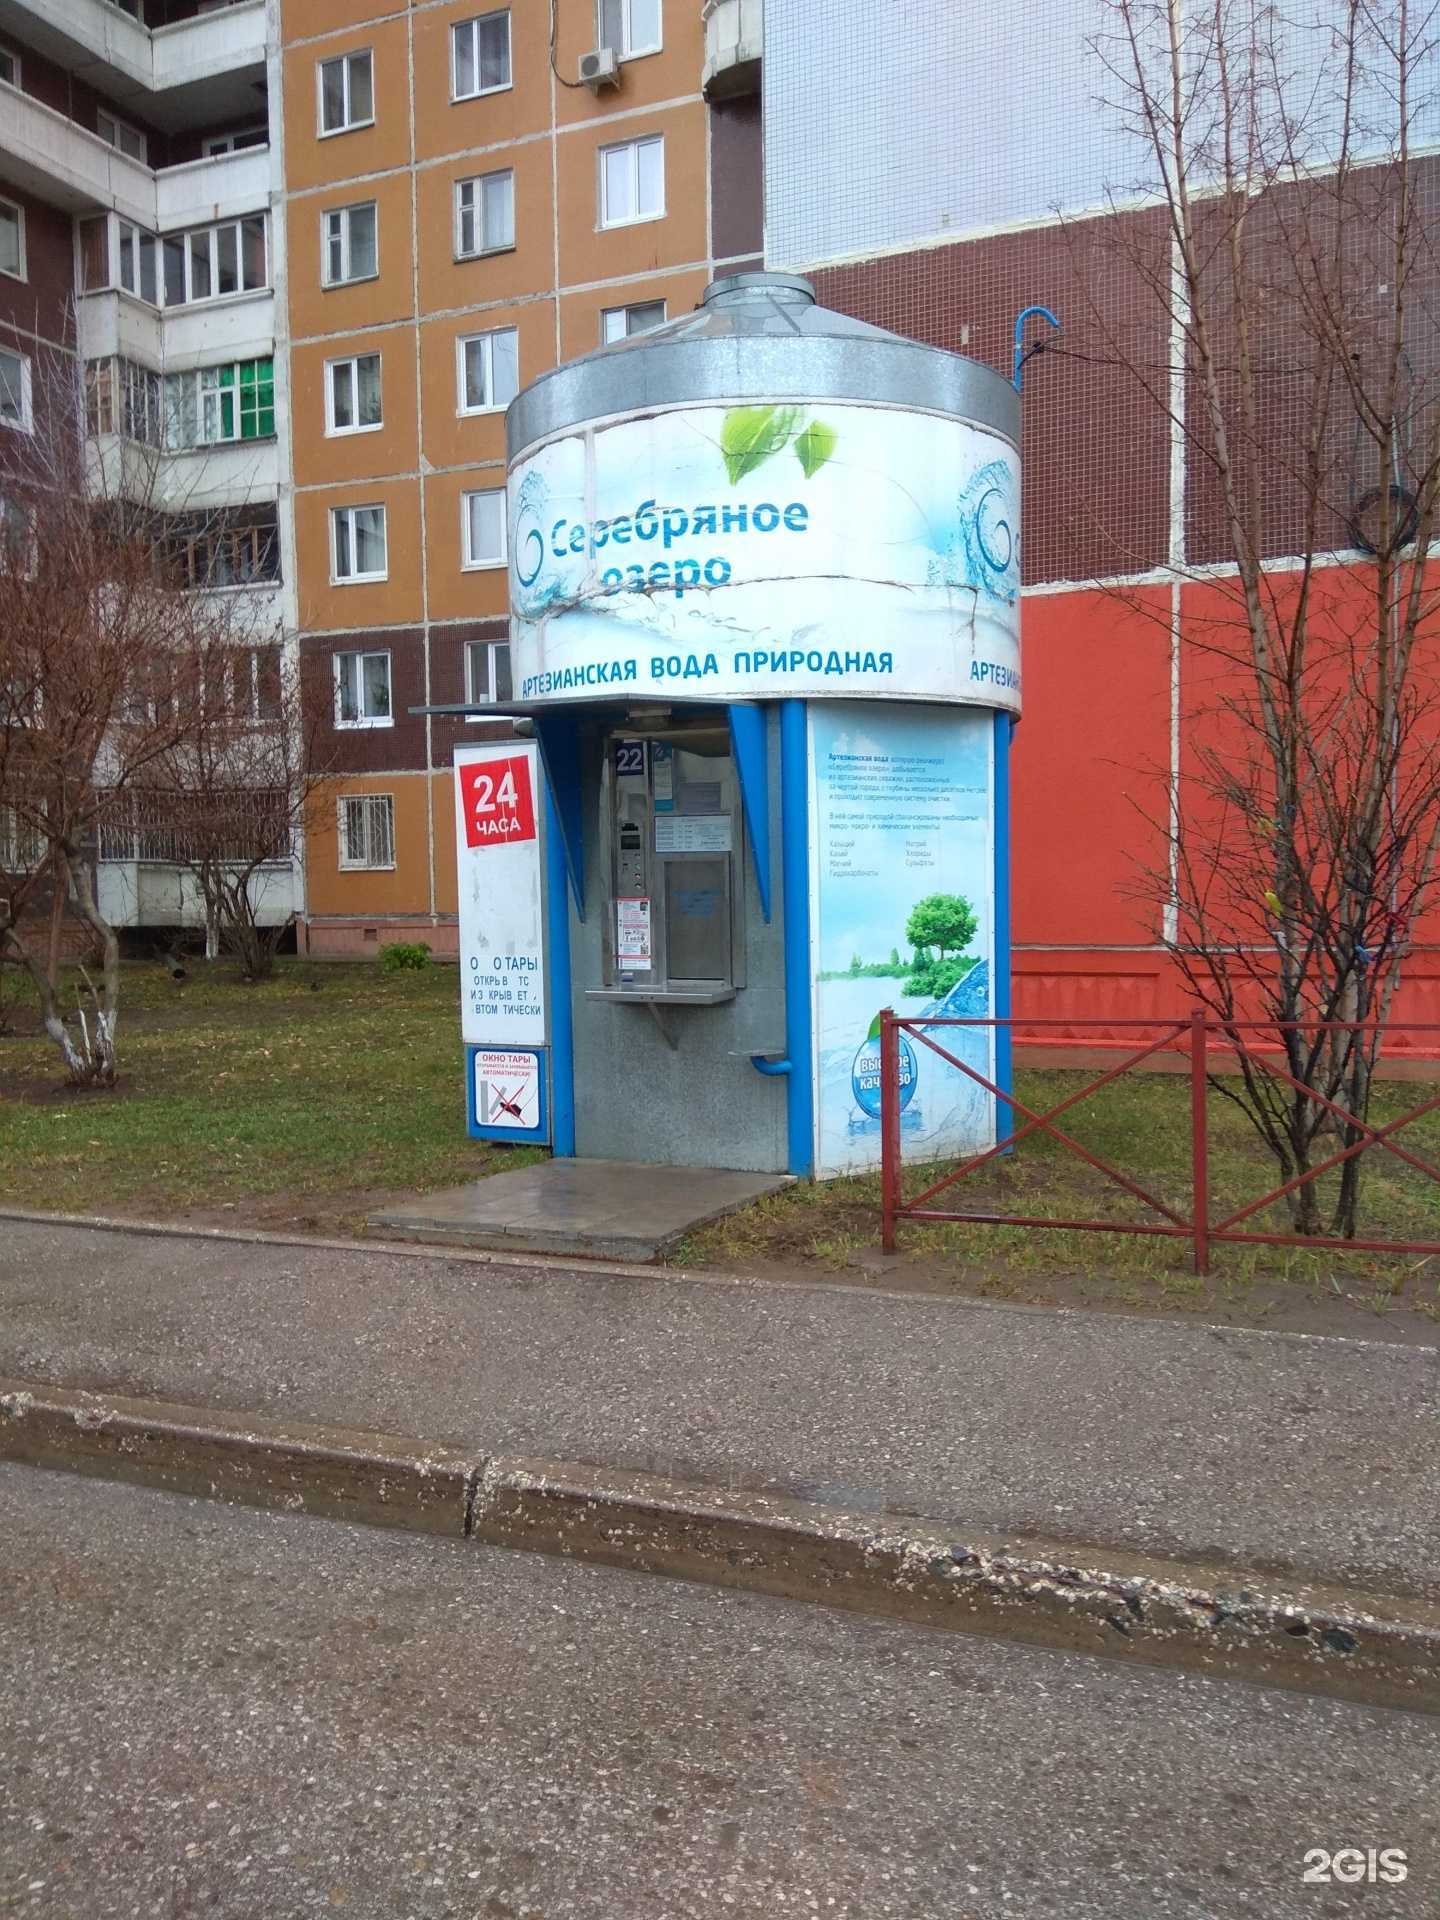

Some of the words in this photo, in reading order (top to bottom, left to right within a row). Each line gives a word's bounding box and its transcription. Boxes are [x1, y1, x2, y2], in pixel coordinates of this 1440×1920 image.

[551, 499, 808, 559] Серебряное
[600, 557, 732, 599] озеро
[522, 659, 637, 698] АРТЕЗИАНСКАЯ
[651, 653, 719, 678] ВОДА
[734, 651, 893, 675] ПРИРОДНАЯ
[617, 748, 642, 771] 22
[473, 771, 518, 813] 24
[476, 817, 521, 836] ЧАСА
[504, 956, 538, 971] ТАРЫ
[482, 1054, 506, 1063] ОКНО
[508, 1055, 531, 1064] ТАРЫ
